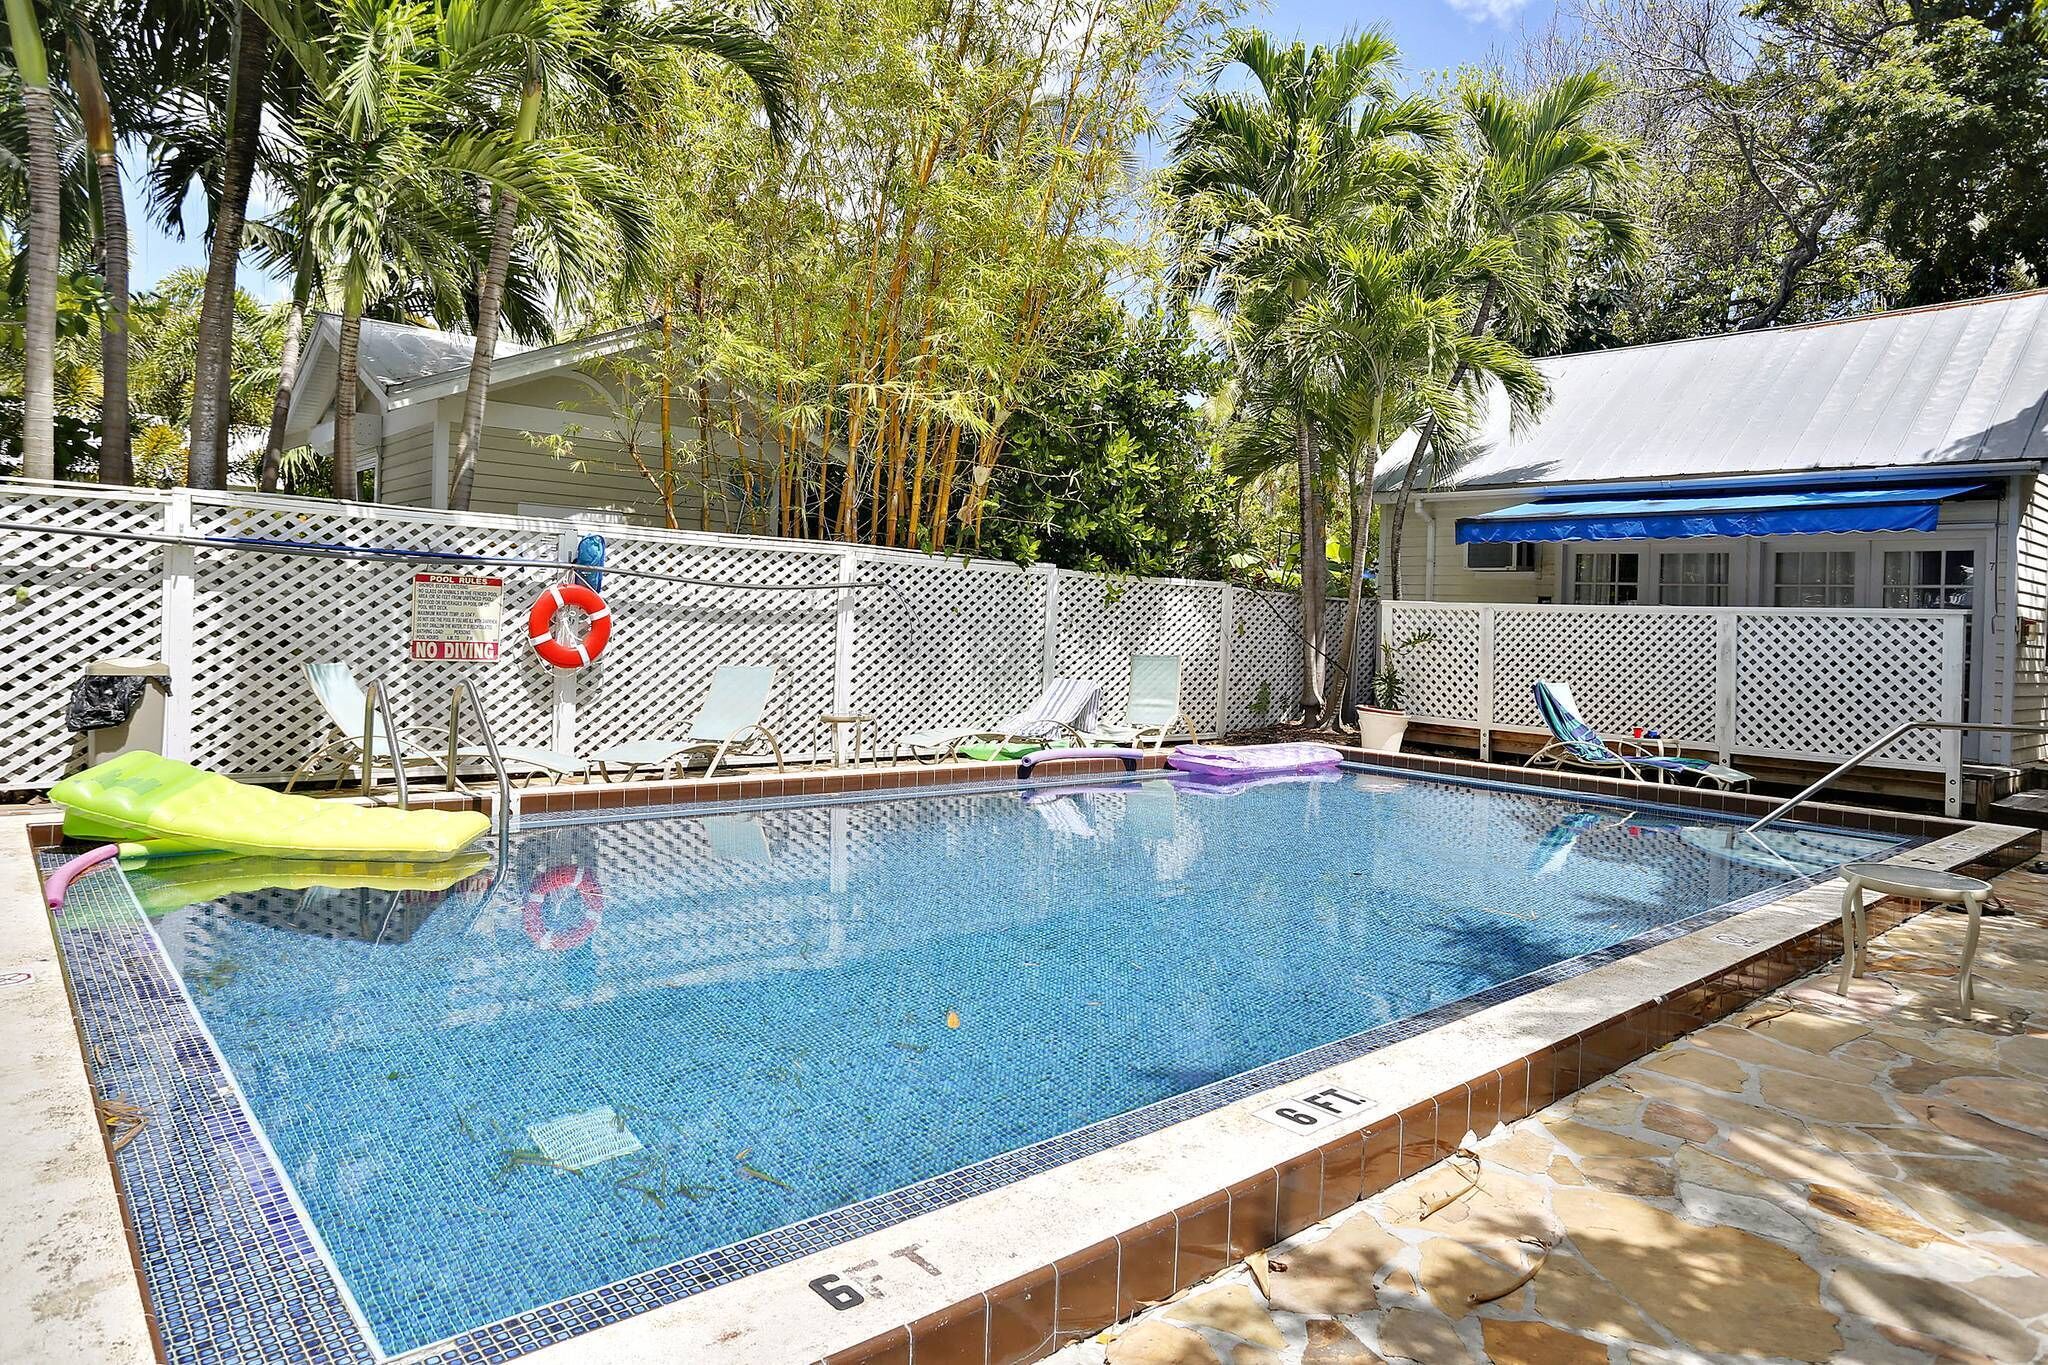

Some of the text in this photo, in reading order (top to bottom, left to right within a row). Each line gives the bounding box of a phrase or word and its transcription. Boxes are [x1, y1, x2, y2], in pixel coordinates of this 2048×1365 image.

[1990, 562, 1996, 571] 7
[416, 642, 494, 659] NO DIVING
[1275, 1088, 1367, 1126] 6 FT.
[808, 1243, 943, 1311] 6 FT
